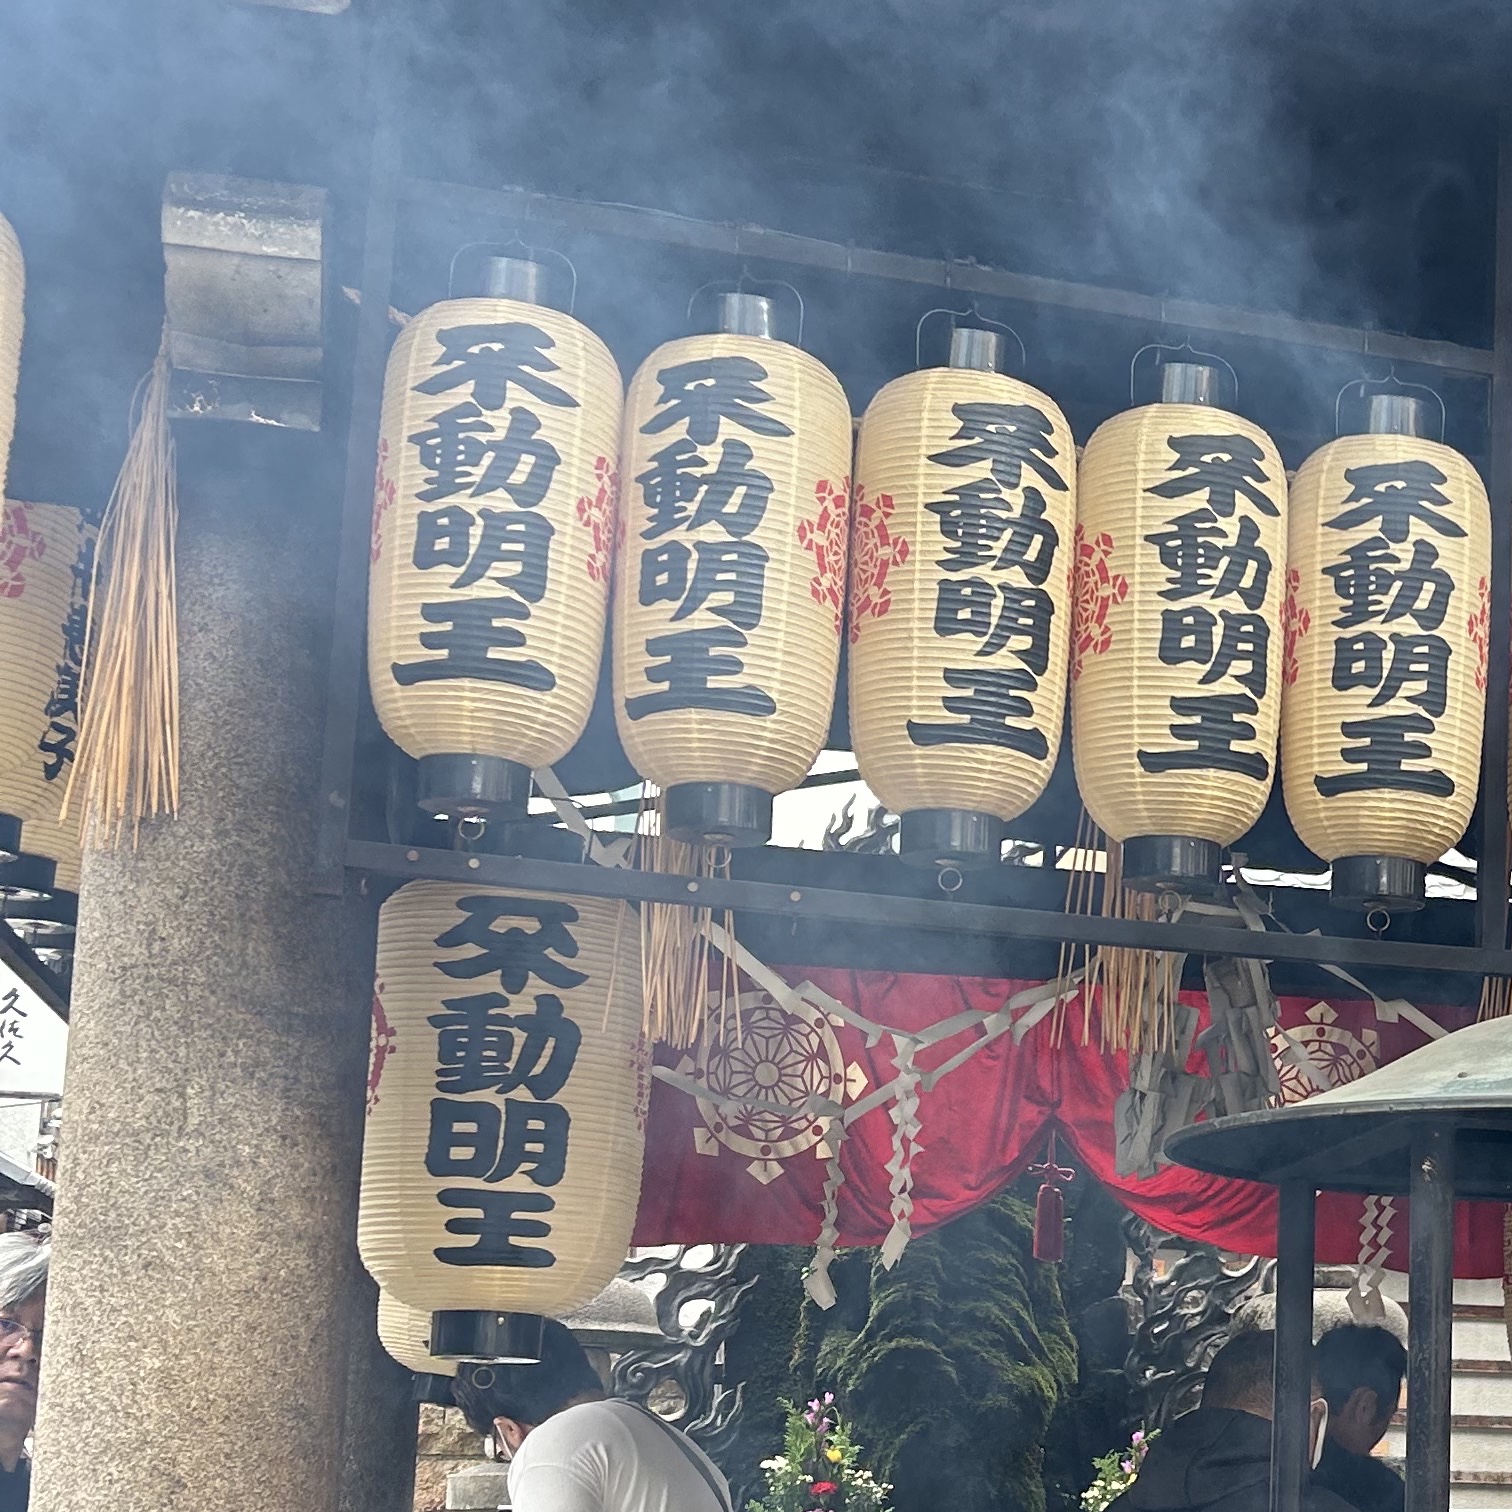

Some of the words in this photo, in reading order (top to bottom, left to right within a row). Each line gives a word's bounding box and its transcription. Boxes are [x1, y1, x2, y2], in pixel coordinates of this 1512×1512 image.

[392, 322, 579, 691] 不動明王
[624, 357, 794, 721] 不動明王
[907, 402, 1067, 761] 不動明王
[1137, 435, 1280, 781] 不動明王
[1314, 461, 1467, 798] 不動明王
[425, 895, 589, 1268] 不動明王
